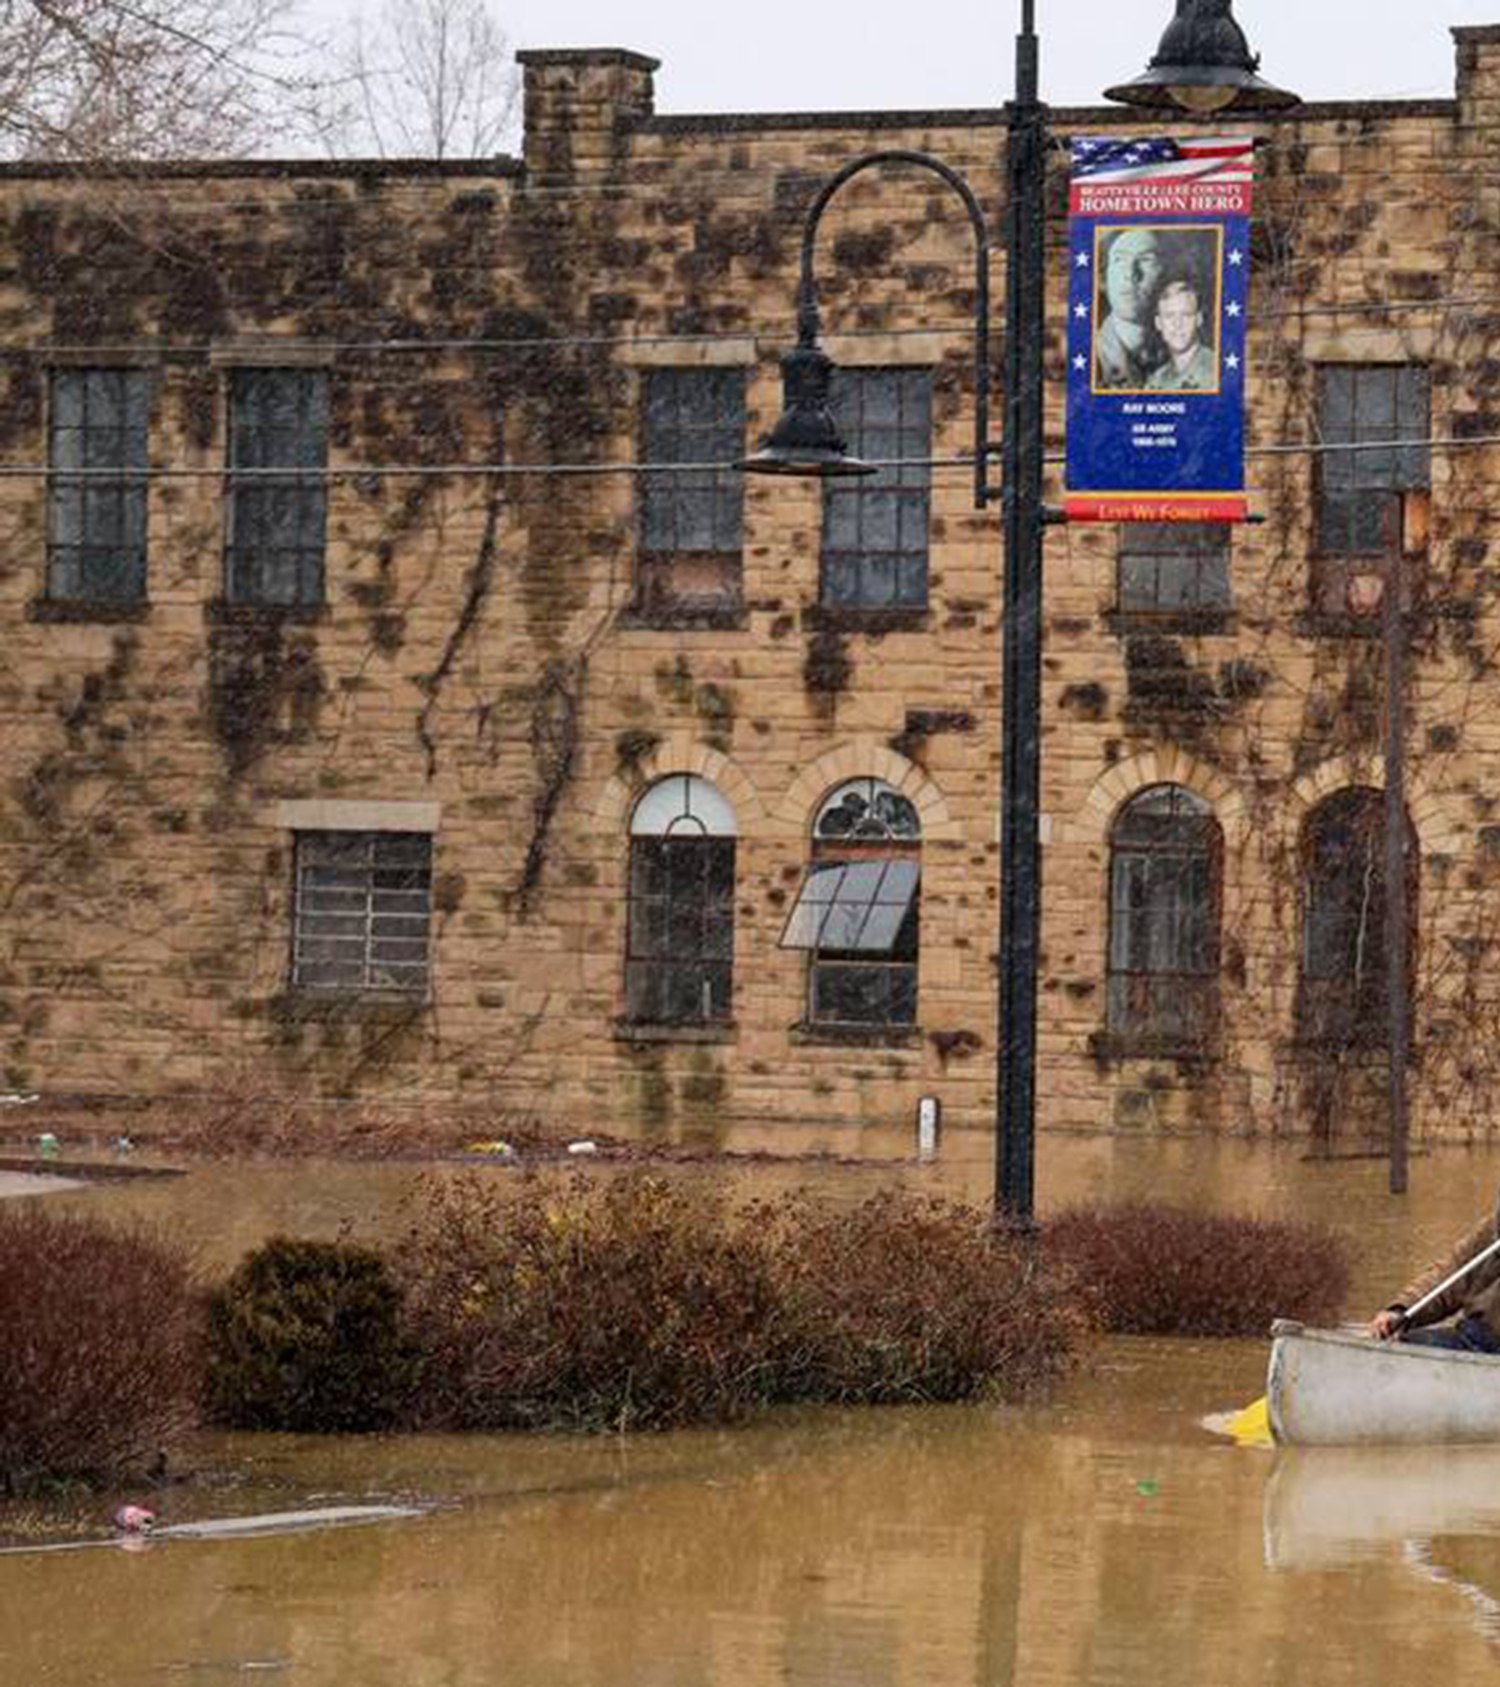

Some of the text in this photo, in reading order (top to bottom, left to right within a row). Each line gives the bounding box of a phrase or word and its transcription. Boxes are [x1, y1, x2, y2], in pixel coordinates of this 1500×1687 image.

[1192, 184, 1242, 196] COUNTY
[1079, 195, 1243, 211] HOMETOWN HERO
[1123, 402, 1186, 414] RAY MOORE
[1147, 423, 1176, 434] ARMY
[1132, 504, 1156, 520] WE
[1159, 503, 1211, 519] FORGET
